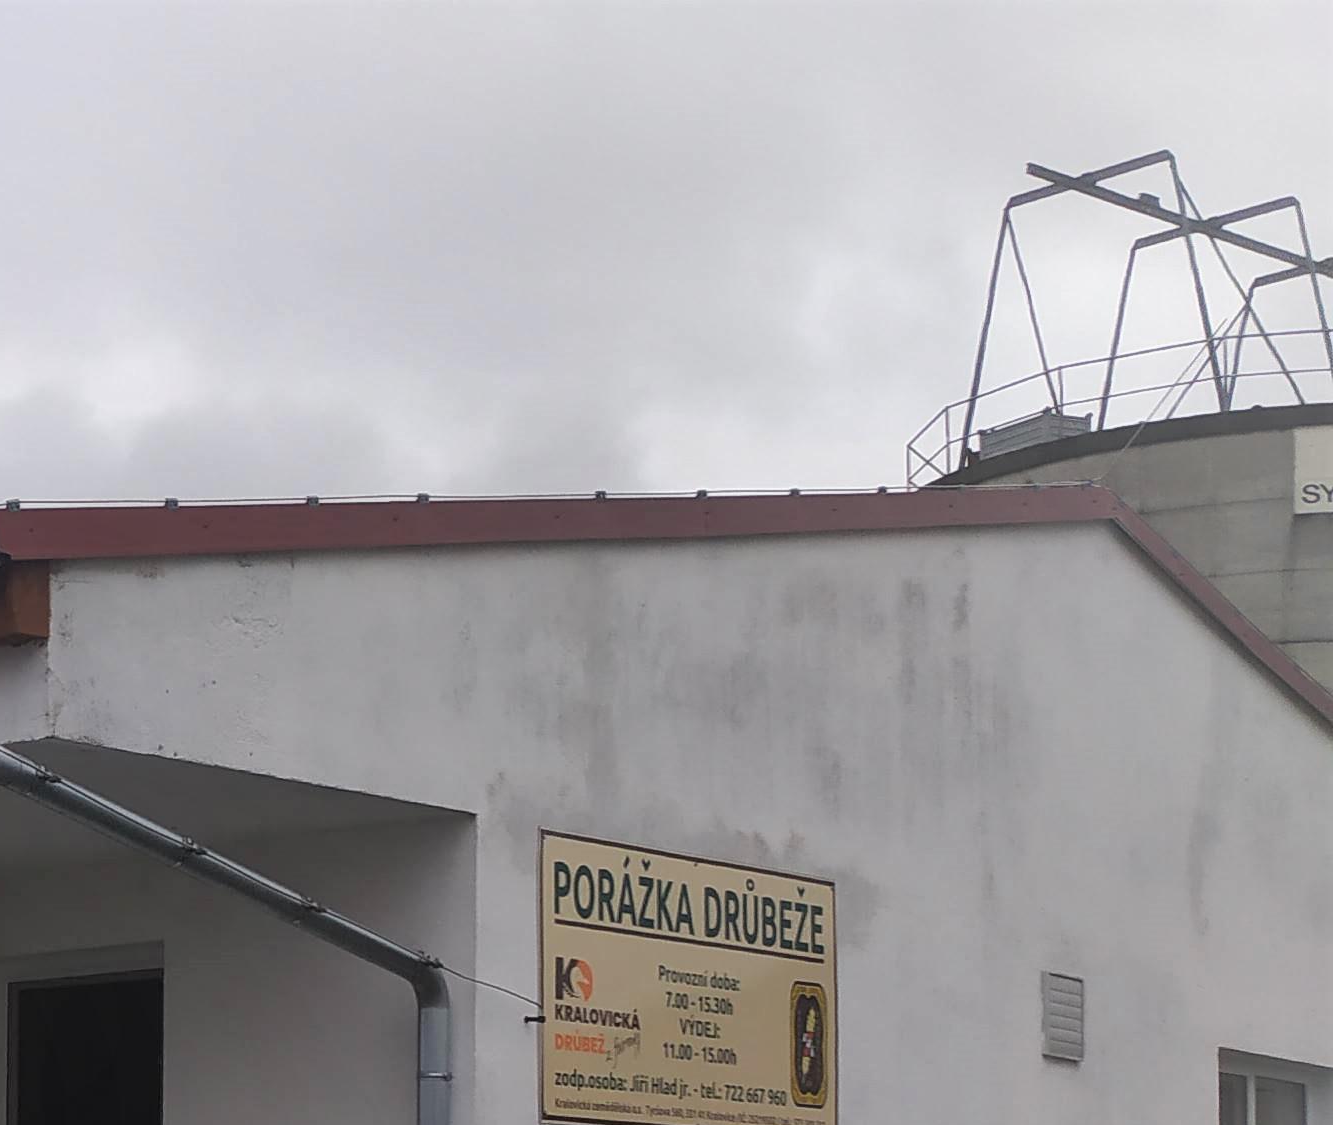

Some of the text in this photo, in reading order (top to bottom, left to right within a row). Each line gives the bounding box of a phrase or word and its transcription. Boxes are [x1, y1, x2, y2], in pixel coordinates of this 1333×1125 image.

[553, 856, 825, 955] PORÁŽKA DRŮBEŽE
[658, 964, 741, 992] Provozní doba:
[554, 1003, 641, 1031] KRALOVICKÁ
[665, 991, 689, 1010] 7.00
[698, 995, 734, 1016] 15.30h
[679, 1014, 721, 1039] VÝDEJ:
[554, 1029, 606, 1055] DRŮBEŽ
[663, 1041, 693, 1061] 11.00
[701, 1046, 738, 1066] 15.00h
[554, 1068, 628, 1092] zodp.osoba:
[651, 1077, 678, 1096] Hlad
[724, 1083, 745, 1102] 722
[746, 1087, 766, 1104] 667
[767, 1088, 788, 1107] 960
